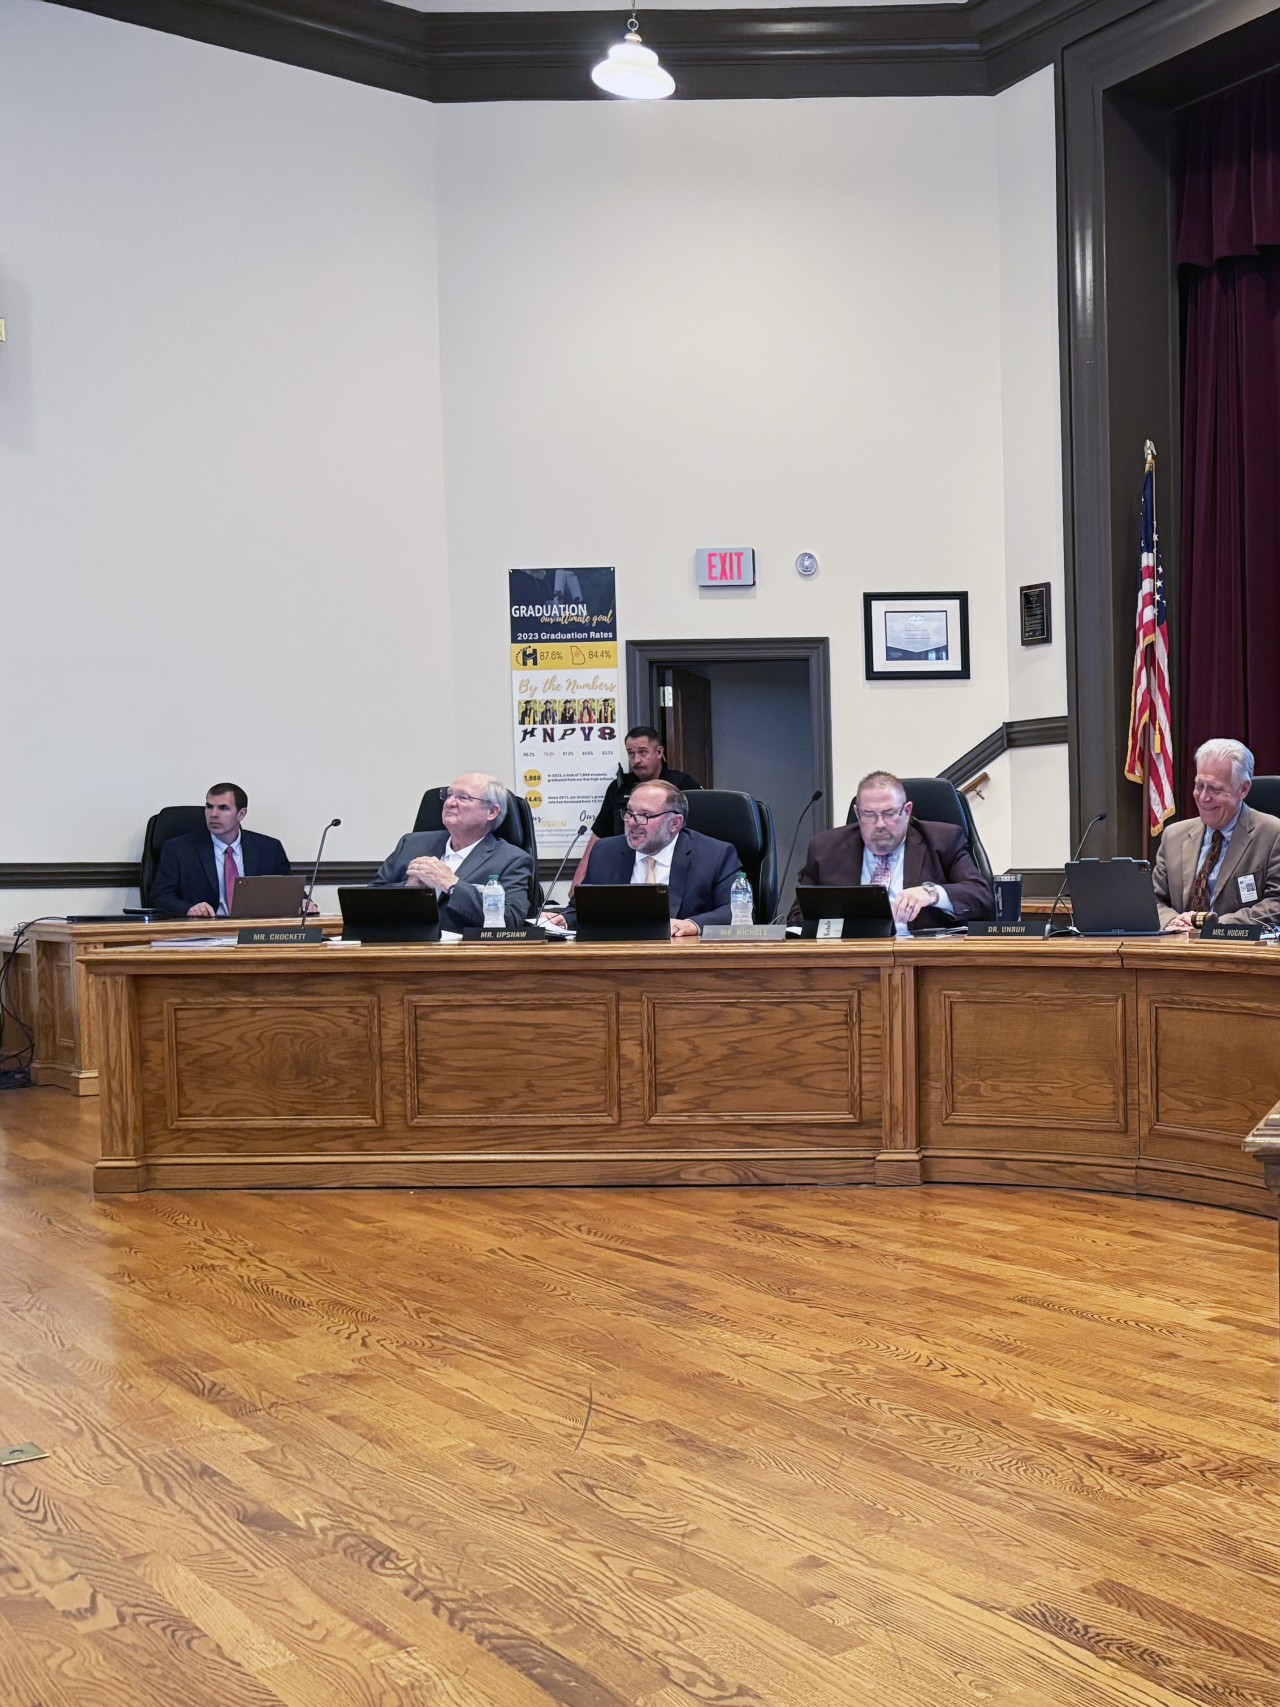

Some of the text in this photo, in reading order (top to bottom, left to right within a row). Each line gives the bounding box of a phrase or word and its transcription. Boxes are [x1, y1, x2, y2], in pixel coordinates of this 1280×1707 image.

[707, 552, 744, 580] EXIT
[511, 604, 587, 617] GRADUATION
[540, 609, 613, 627] our ultimate goal
[540, 632, 588, 640] Graduation
[590, 631, 613, 639] Rates
[539, 651, 563, 660] 87.6%
[588, 650, 611, 660] 84.4%
[519, 675, 617, 698] By the Numbers
[542, 727, 555, 743] N
[558, 727, 576, 741] P
[737, 928, 768, 936] NICHOLS
[1212, 928, 1249, 937] MRS. HUGHES
